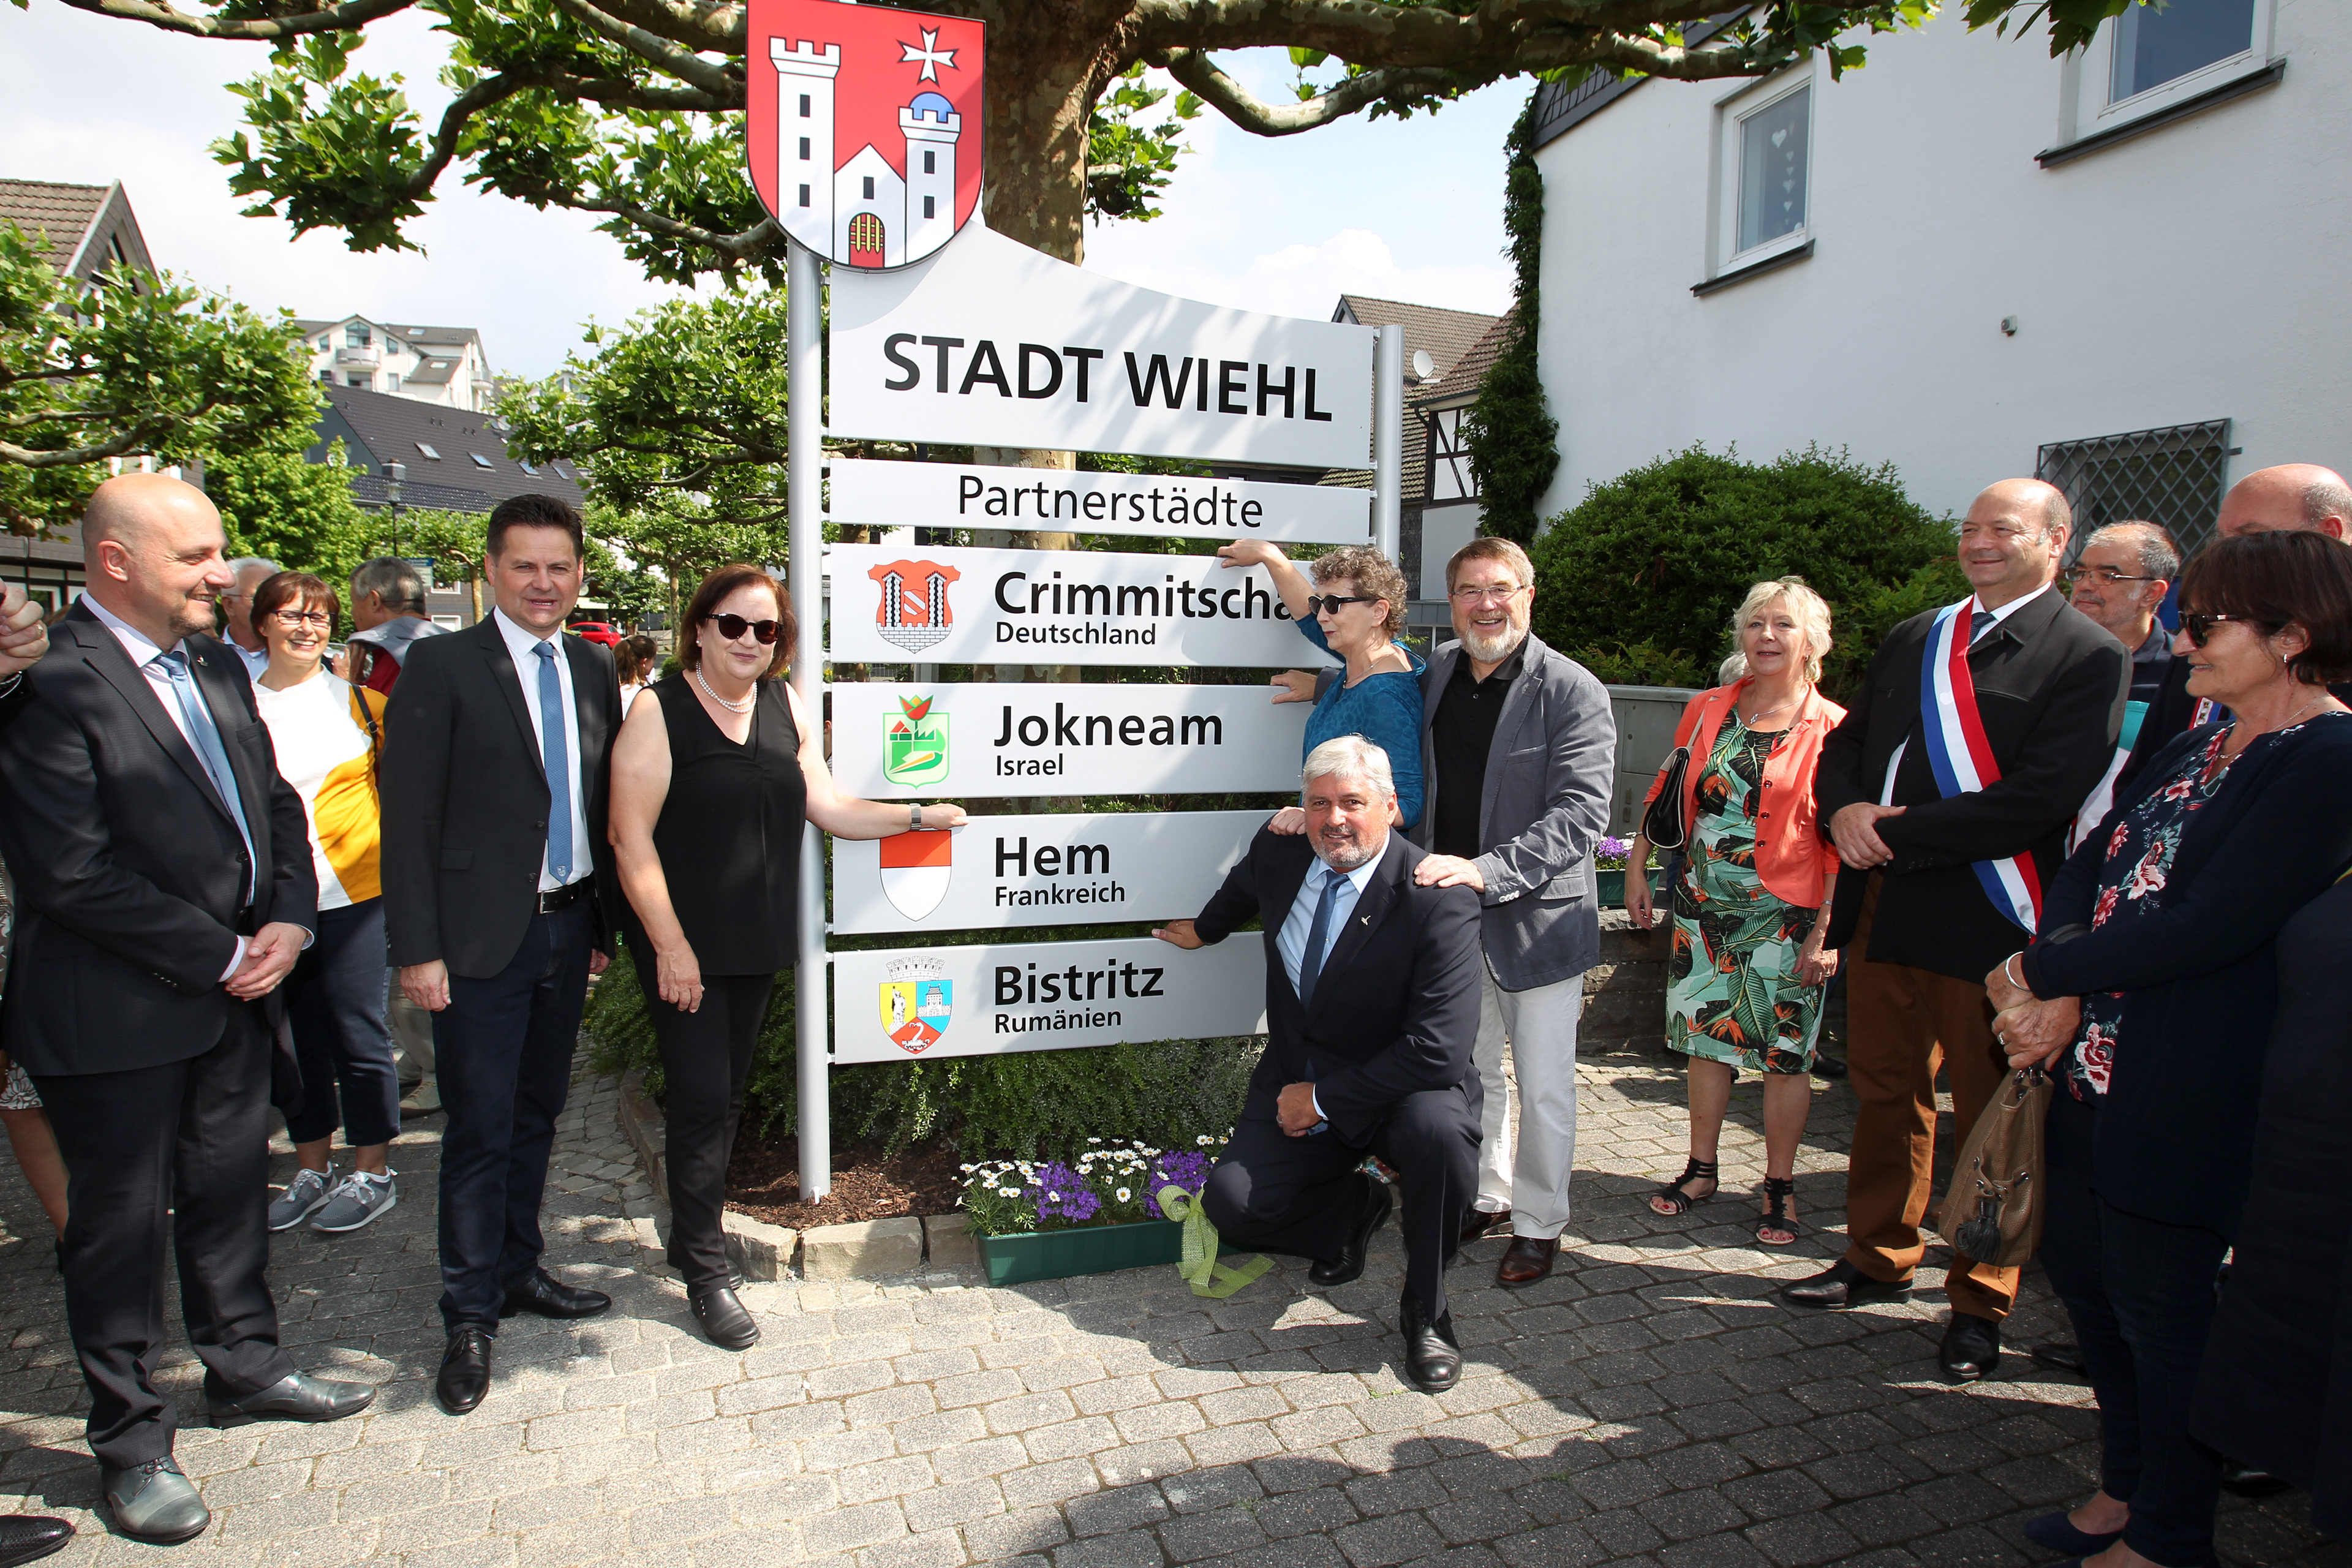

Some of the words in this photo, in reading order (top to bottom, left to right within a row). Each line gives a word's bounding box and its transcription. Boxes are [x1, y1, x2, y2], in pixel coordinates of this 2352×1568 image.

[884, 333, 1104, 403] STADT
[1123, 352, 1332, 422] WIEHL
[960, 475, 1262, 528] Partnerstädte
[997, 622, 1156, 645] Deutschland
[994, 703, 1222, 747] Jokneam
[997, 753, 1063, 776] Israel
[995, 837, 1109, 877] Hem
[995, 880, 1125, 907] Frankreich
[995, 958, 1164, 1006] Bistritz
[995, 1007, 1121, 1034] Rumänien
